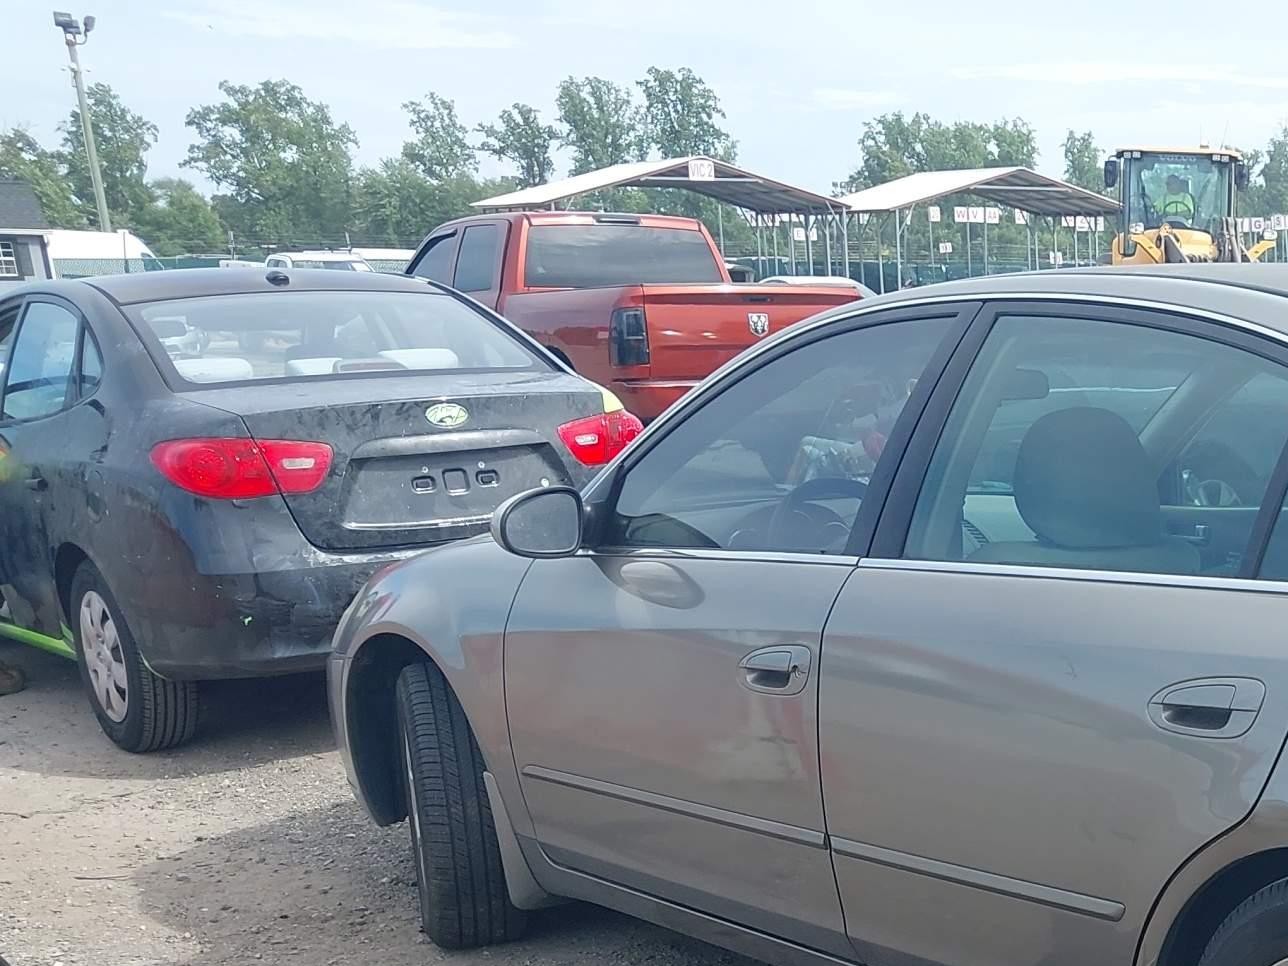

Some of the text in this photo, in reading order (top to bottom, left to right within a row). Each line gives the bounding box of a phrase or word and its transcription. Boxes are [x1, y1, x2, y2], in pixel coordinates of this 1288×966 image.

[689, 163, 714, 178] VIC 2
[956, 209, 966, 219] W
[1254, 220, 1262, 229] G
